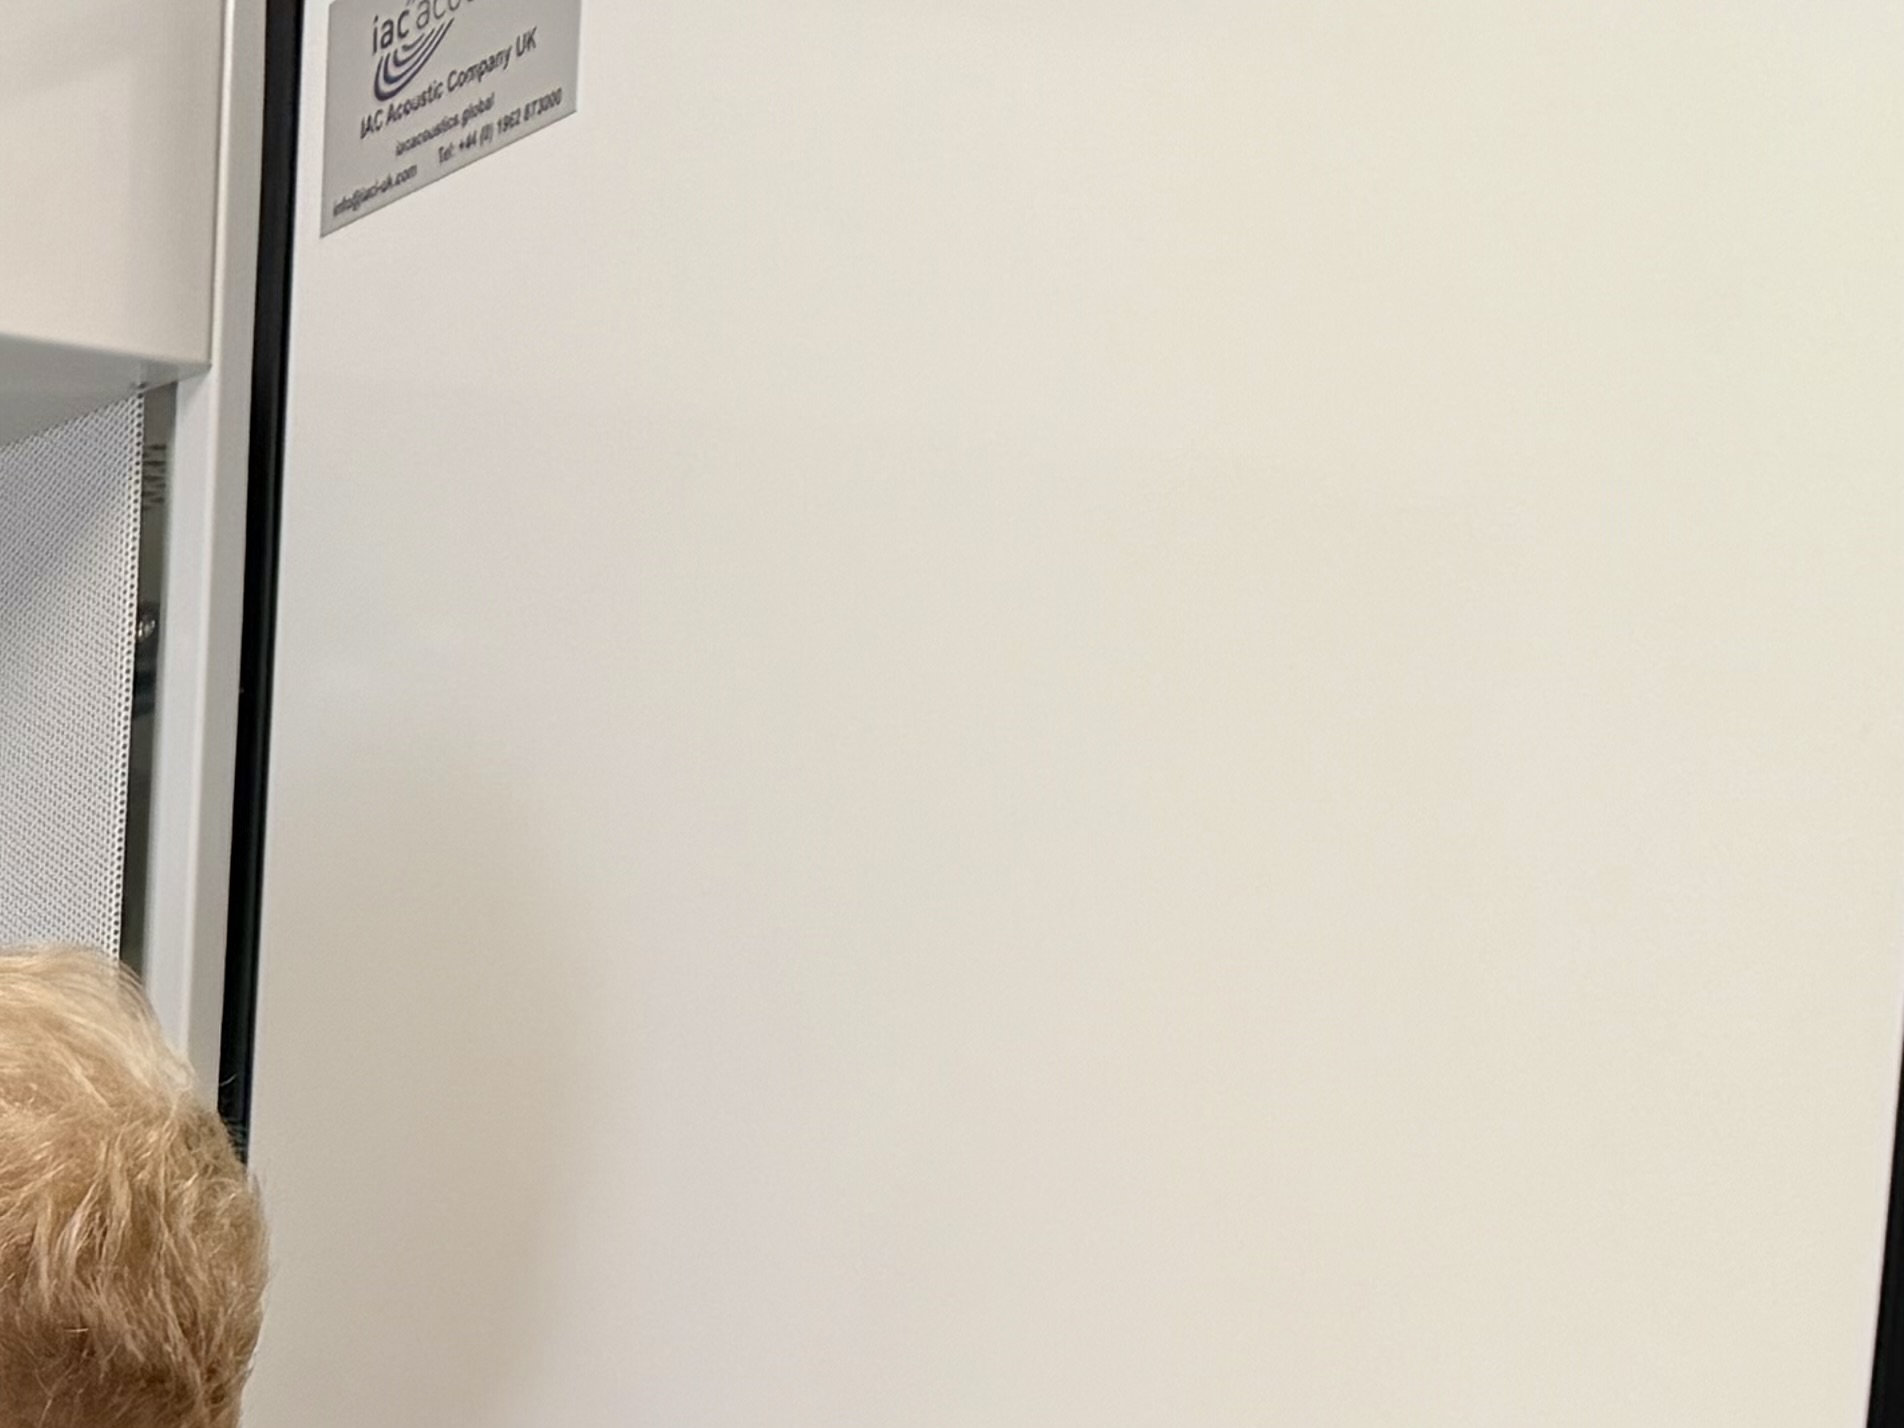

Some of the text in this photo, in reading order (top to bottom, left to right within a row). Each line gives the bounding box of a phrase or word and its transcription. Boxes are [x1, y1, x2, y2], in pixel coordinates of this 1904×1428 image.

[372, 14, 410, 55] iac
[385, 79, 444, 127] Acoustic
[447, 45, 513, 93] Company
[515, 25, 538, 58] UK
